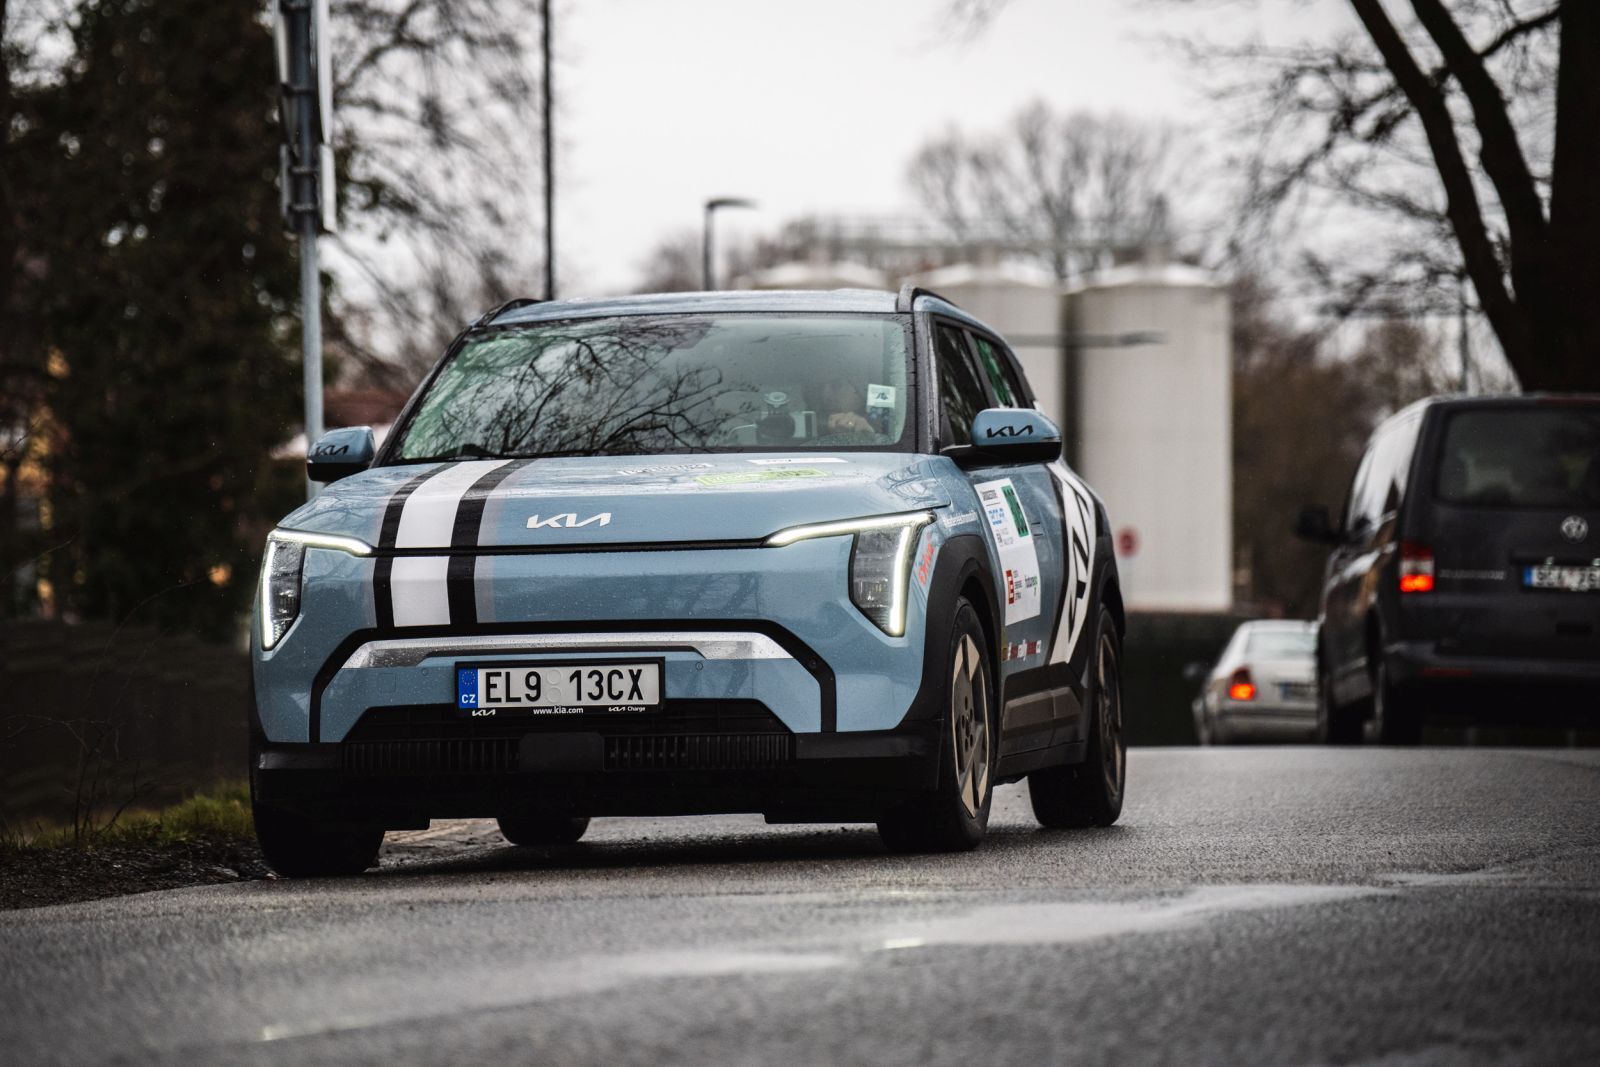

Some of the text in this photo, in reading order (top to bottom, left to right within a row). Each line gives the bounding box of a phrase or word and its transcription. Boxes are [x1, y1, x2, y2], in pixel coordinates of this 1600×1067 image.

[986, 424, 1034, 439] KIA
[315, 444, 349, 457] KIA
[526, 512, 612, 529] KIA
[485, 668, 644, 704] EL9 13CX
[461, 693, 476, 704] CZ
[471, 708, 497, 717] KIA
[533, 705, 584, 715] www.kia.com
